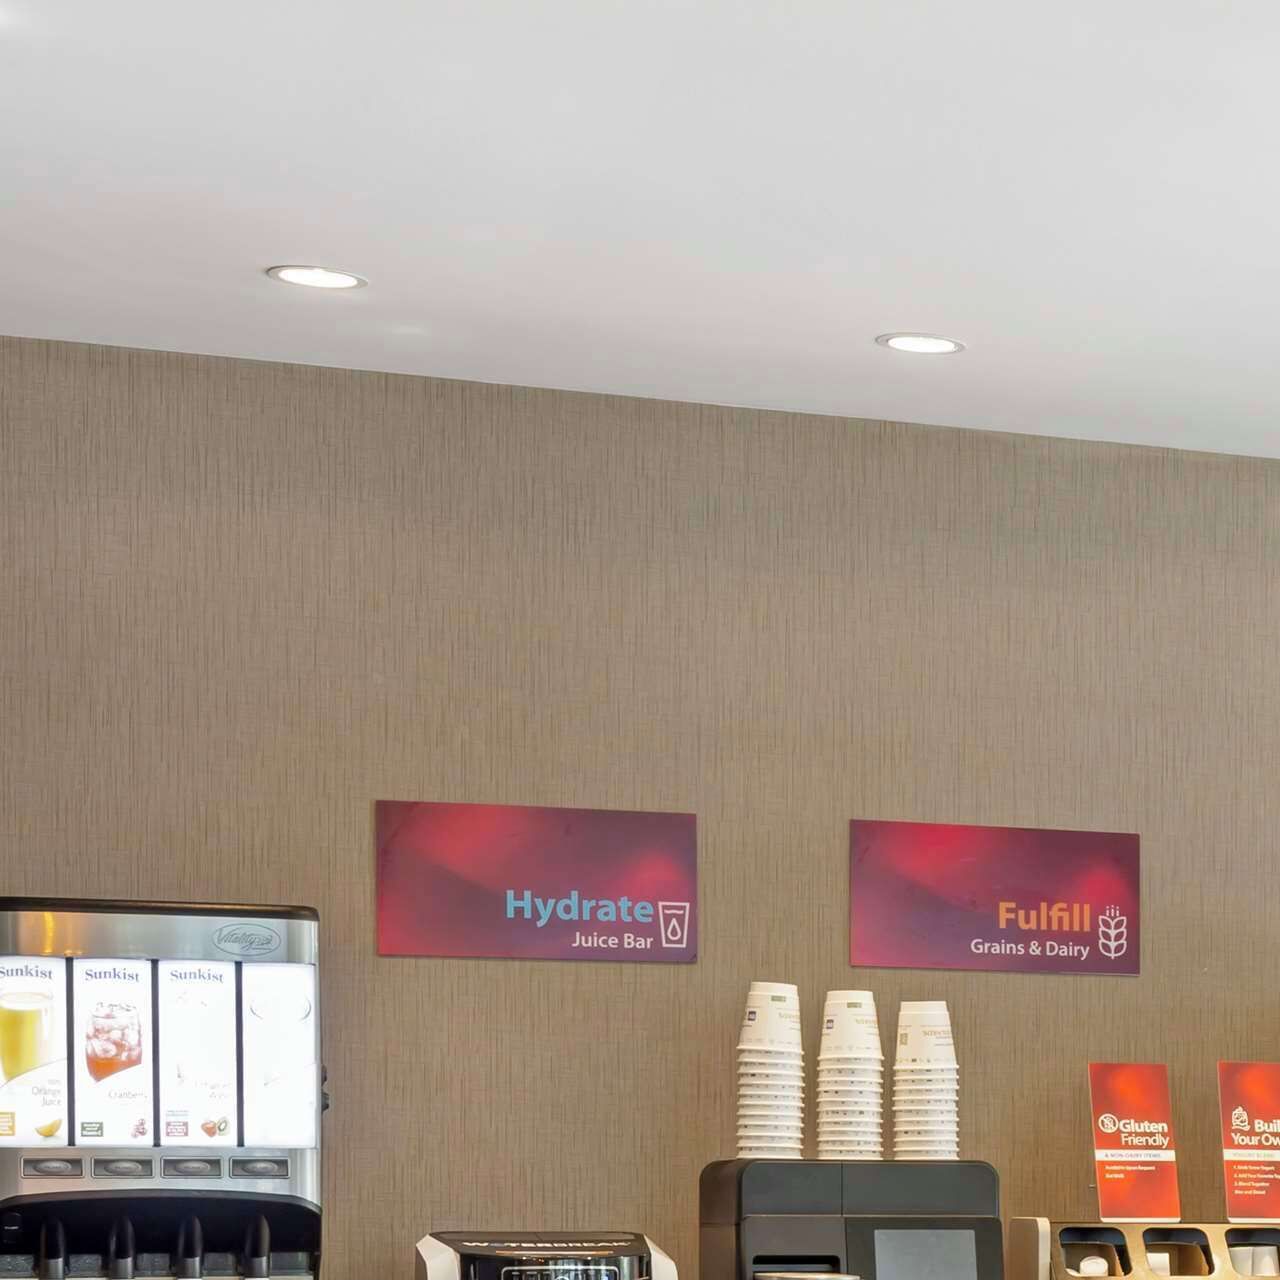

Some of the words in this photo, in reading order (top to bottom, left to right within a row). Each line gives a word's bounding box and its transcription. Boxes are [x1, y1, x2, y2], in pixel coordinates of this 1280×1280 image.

[506, 889, 654, 928] Hydrate
[1000, 902, 1091, 932] Fulfill
[571, 932, 619, 948] Juice
[623, 933, 653, 949] Bar
[970, 938, 1025, 955] Grains
[1028, 941, 1042, 956] &
[1046, 942, 1090, 960] Dairy
[0, 965, 53, 980] Sunkist
[85, 968, 139, 982] Sunkist
[170, 969, 224, 983] Sunkist
[1119, 1119, 1168, 1133] Gluten
[1121, 1133, 1170, 1149] Friendly
[1231, 1132, 1260, 1146] Your
